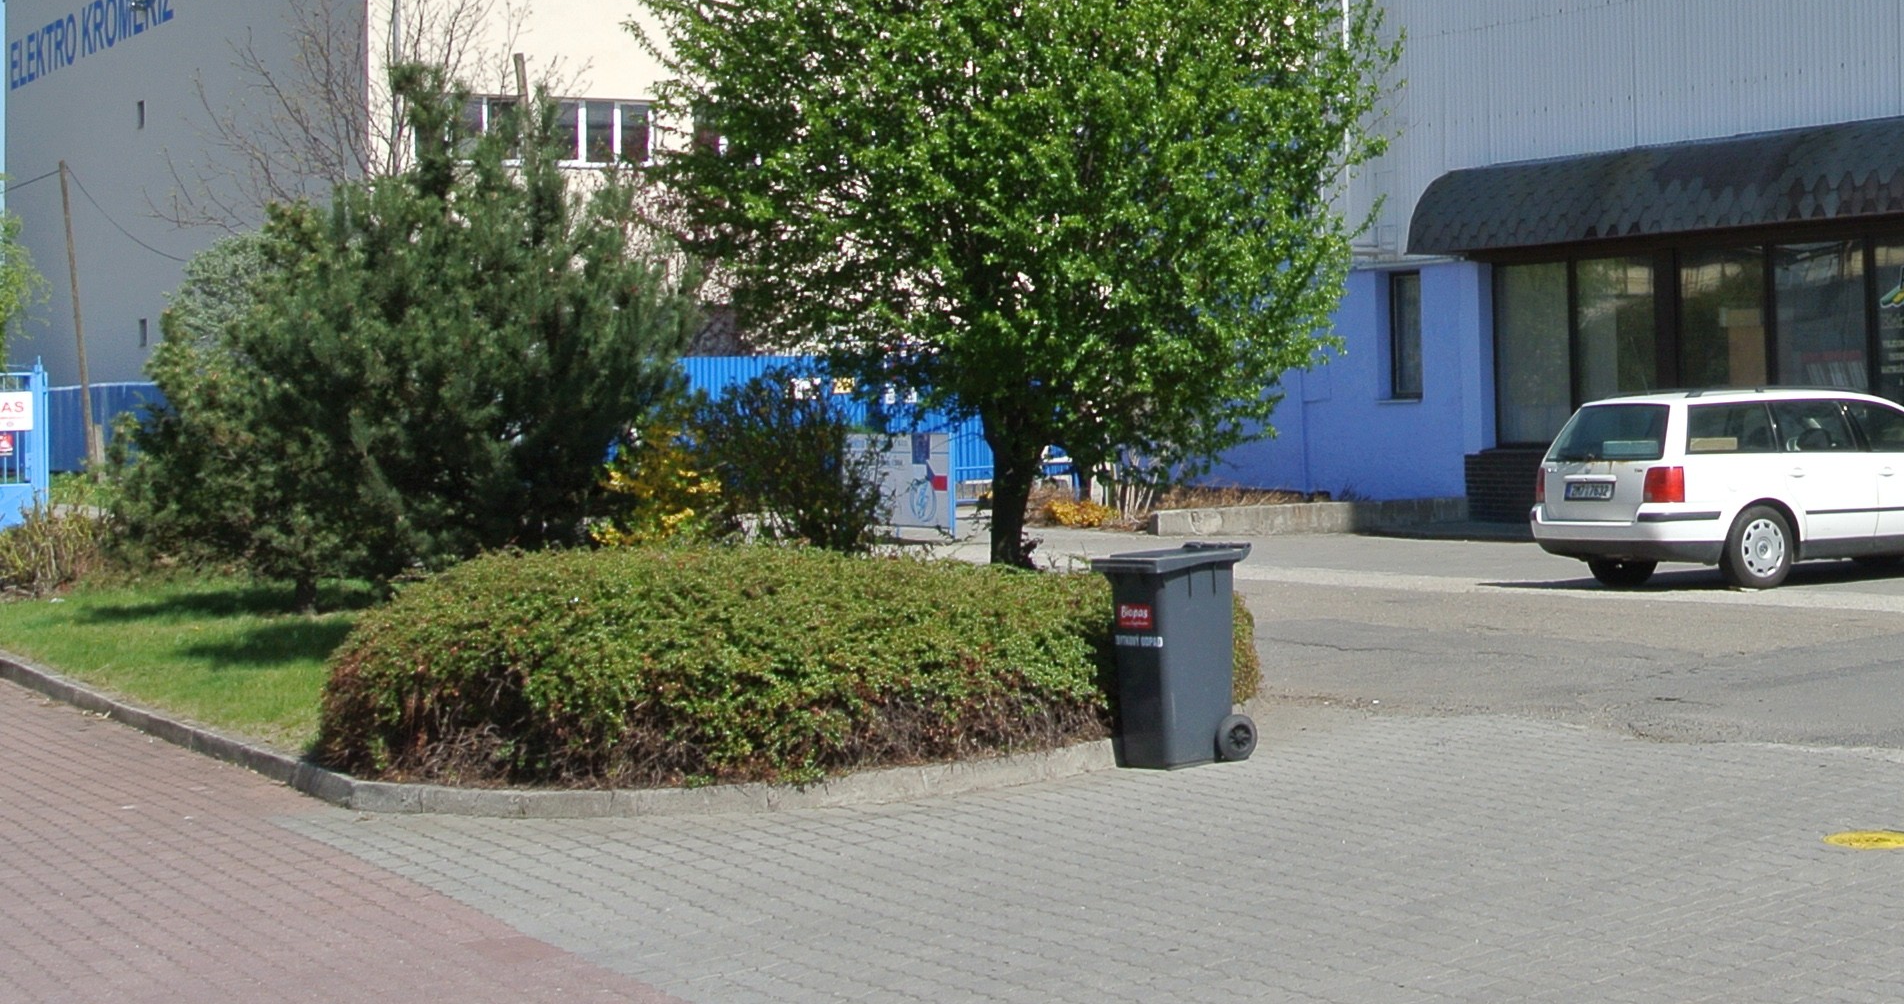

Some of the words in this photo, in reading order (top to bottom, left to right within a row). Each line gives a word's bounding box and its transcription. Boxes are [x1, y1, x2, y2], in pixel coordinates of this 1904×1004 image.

[10, 12, 77, 91] ELEKTRO
[2, 401, 24, 413] AS
[1121, 604, 1148, 619] Biopas
